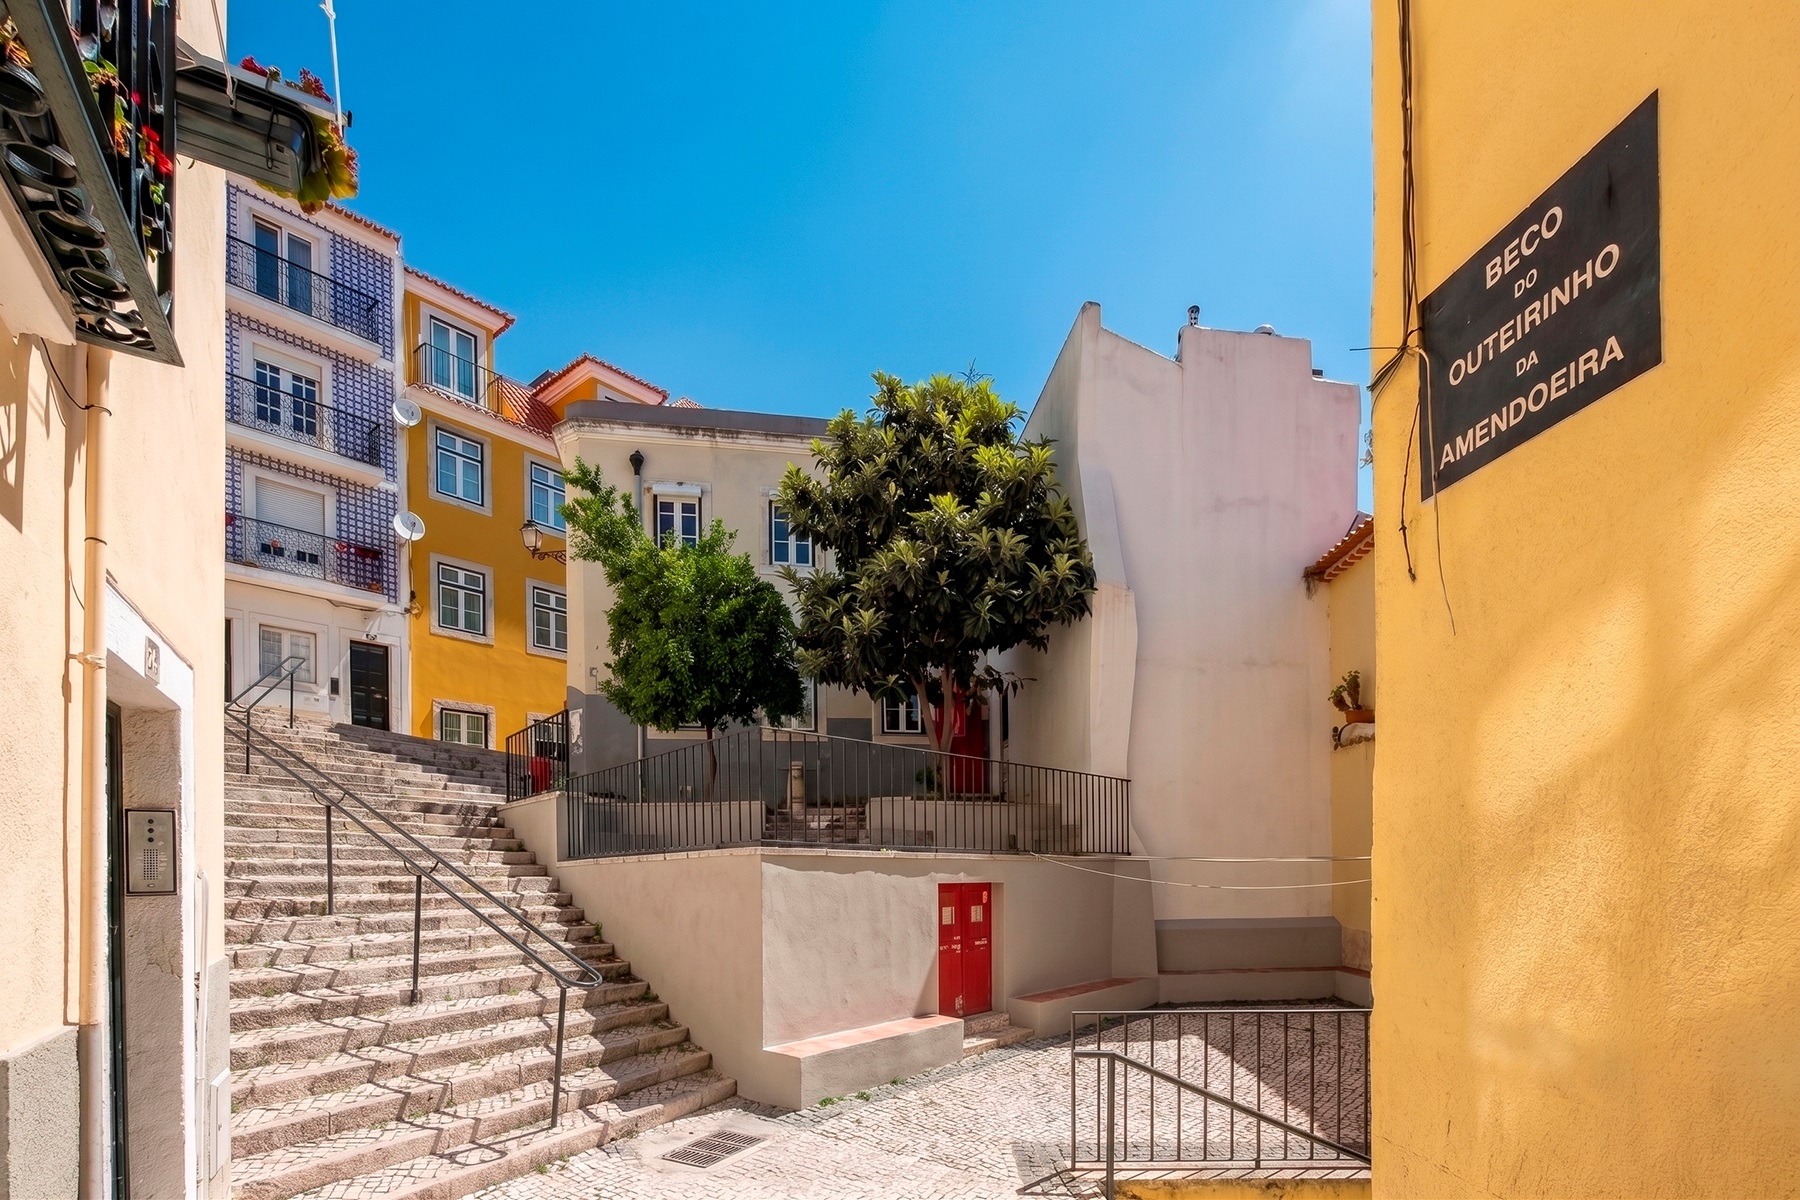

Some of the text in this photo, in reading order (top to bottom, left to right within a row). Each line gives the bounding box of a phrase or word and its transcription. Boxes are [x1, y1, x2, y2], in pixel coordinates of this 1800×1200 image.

[1485, 206, 1563, 290] BECO
[1514, 268, 1538, 299] DO
[1449, 243, 1620, 386] OUTEIRINHO
[1439, 335, 1625, 471] AMENDOEIRA
[1516, 350, 1539, 377] DA
